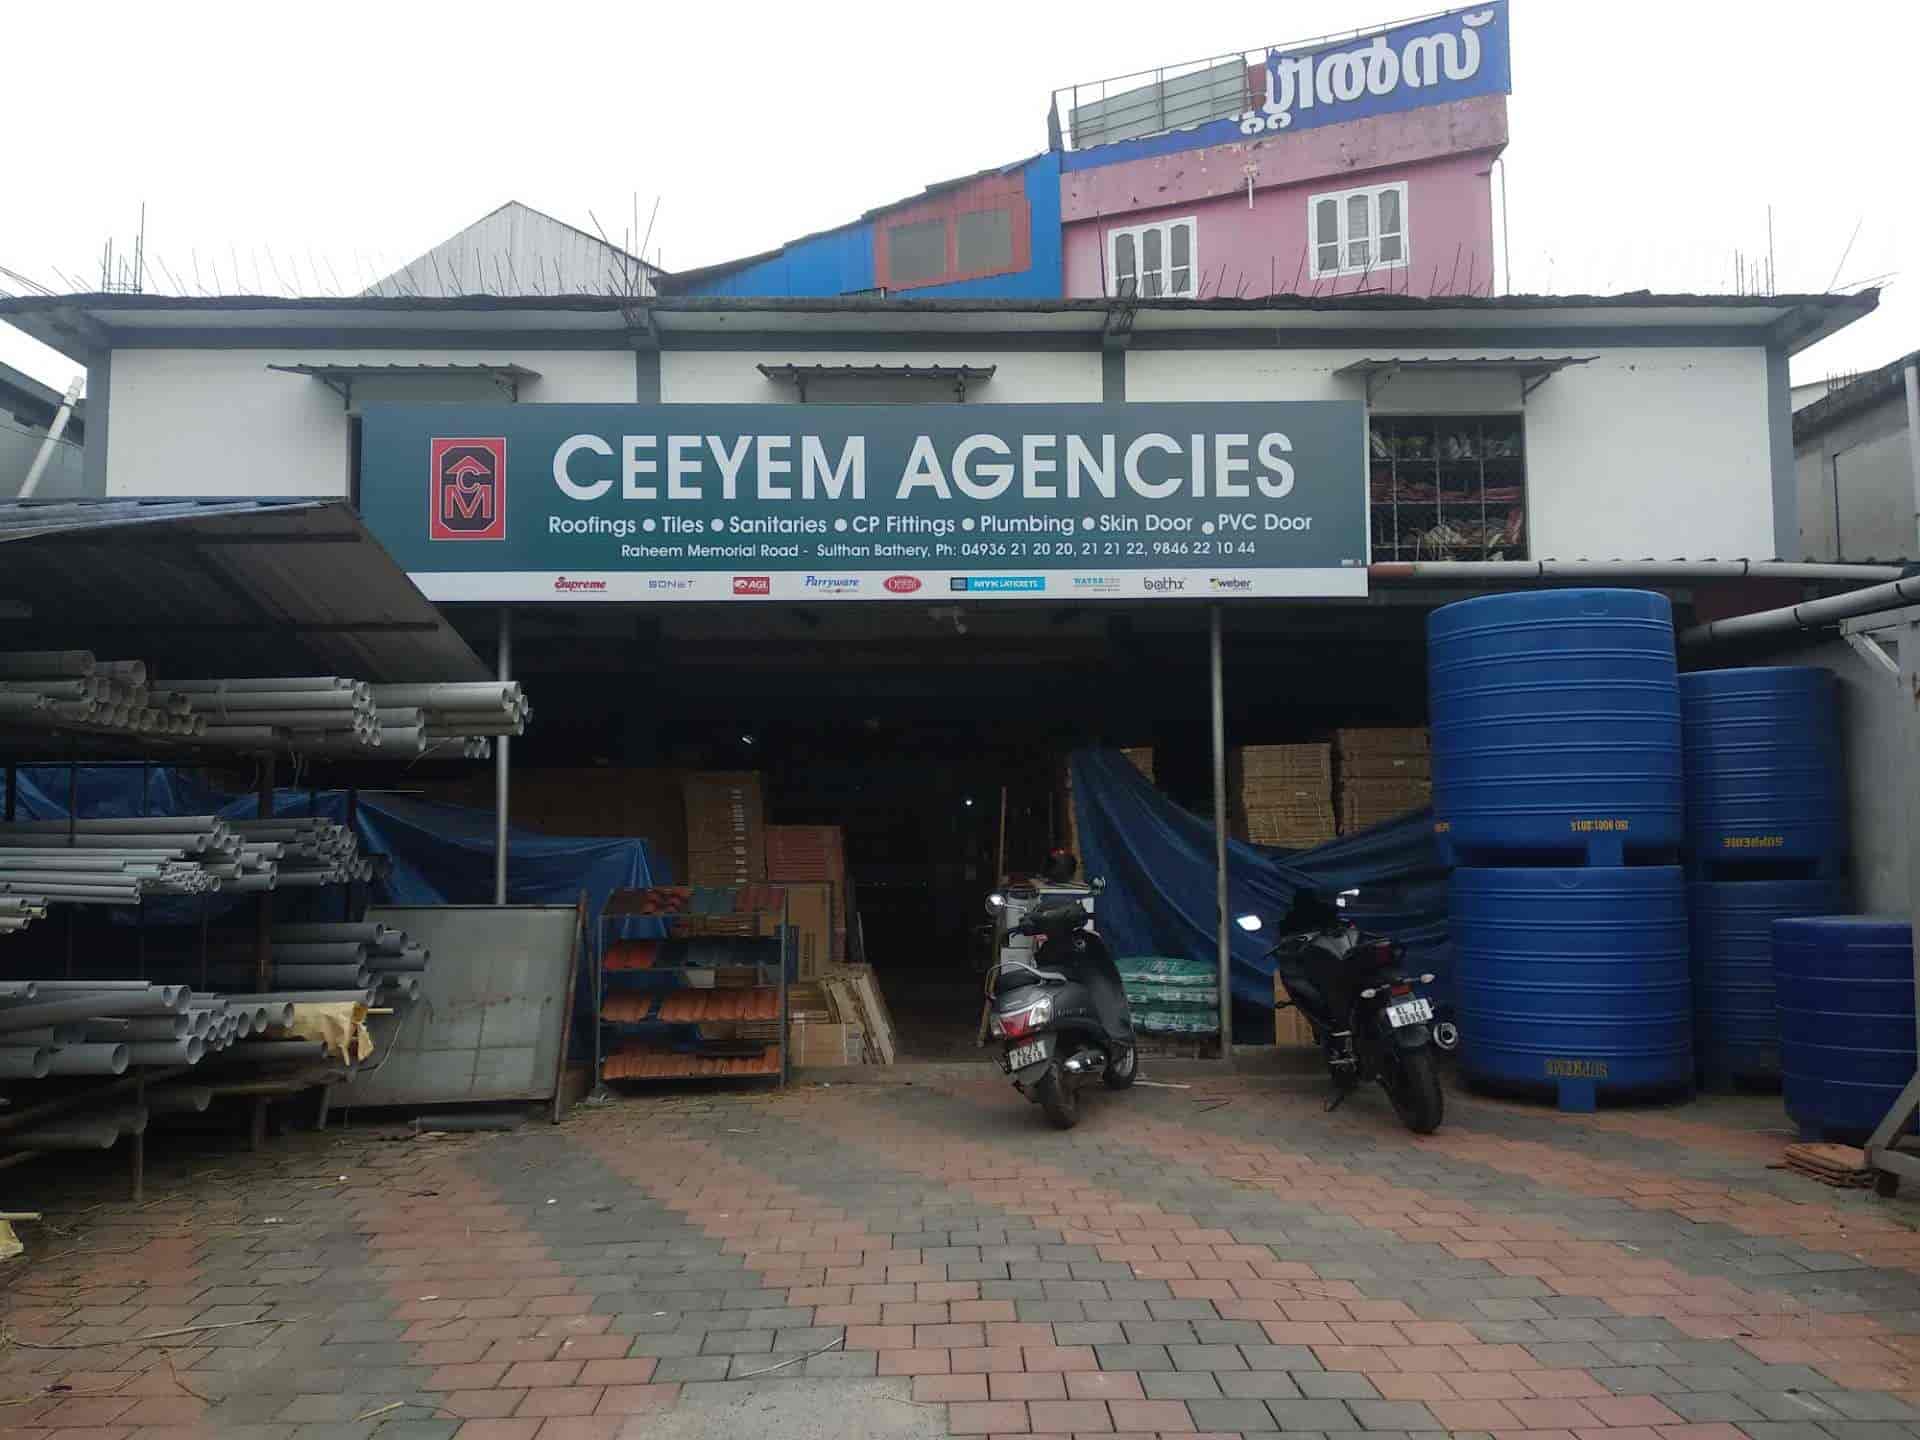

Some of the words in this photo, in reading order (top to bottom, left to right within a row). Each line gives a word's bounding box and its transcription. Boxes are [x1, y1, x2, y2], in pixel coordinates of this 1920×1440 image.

[553, 434, 866, 501] CEEYEM
[896, 433, 1295, 500] AGENCIES
[549, 515, 636, 538] Roofings
[661, 516, 704, 533] Tiles
[729, 515, 827, 533] Sanitaries
[852, 516, 880, 533] CP
[886, 515, 955, 537] Fittings
[980, 514, 1075, 537] Plumbing
[1099, 514, 1139, 532] Skin
[1145, 514, 1193, 532] Door
[1218, 513, 1257, 532] PVC
[1263, 513, 1313, 532] Door
[621, 544, 683, 557] Raheem
[687, 543, 756, 557] Memorial
[760, 543, 799, 557] Road
[816, 543, 870, 557] Sulthan
[935, 543, 957, 556] Ph:
[961, 543, 1006, 556] 04936
[1010, 542, 1027, 556] 21
[1033, 542, 1051, 556] 20
[1081, 542, 1097, 556] 21
[1103, 542, 1120, 556] 21
[1151, 542, 1189, 555] 9846
[1192, 541, 1211, 555] 22
[1216, 541, 1234, 555] 10
[1237, 541, 1256, 554] 44
[554, 576, 607, 591] Supreme
[804, 575, 861, 588] Parryware
[1219, 578, 1251, 589] weber
